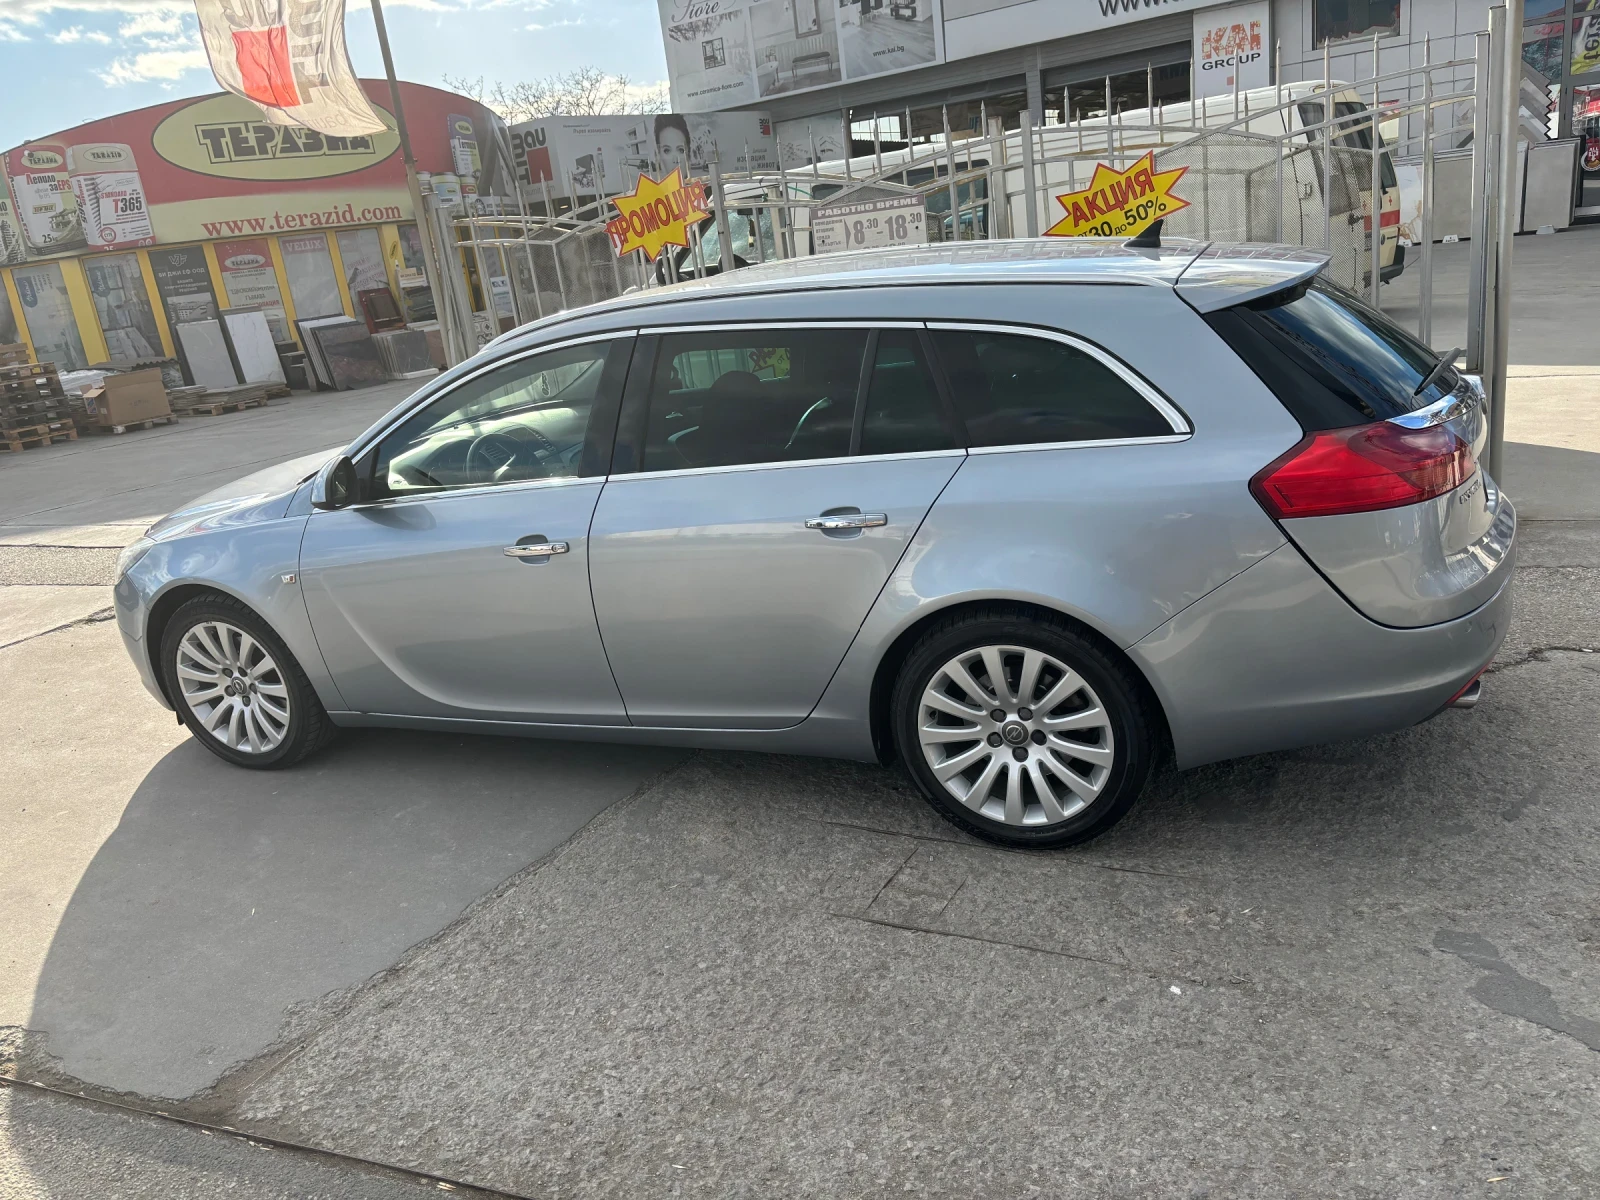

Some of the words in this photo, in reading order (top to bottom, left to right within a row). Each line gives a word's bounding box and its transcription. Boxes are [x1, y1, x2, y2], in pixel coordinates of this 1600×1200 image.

[872, 45, 905, 57] www.kai.bg
[1202, 52, 1261, 71] GROUP
[687, 81, 744, 98] www.ceramica-fiore.com
[25, 173, 56, 186] Лепило
[49, 184, 59, 192] за
[57, 179, 72, 191] EPS
[112, 196, 143, 213] T365
[817, 202, 874, 218] РАБОТНО
[876, 196, 919, 210] ВРЕМЕ
[1071, 168, 1156, 229] АКЦИЯ
[201, 203, 403, 237] www.terazid.com
[605, 180, 709, 249] ПРОМОЦИЯ
[1114, 223, 1128, 236] до
[1124, 196, 1167, 227] 50%
[285, 240, 322, 252] VELUX
